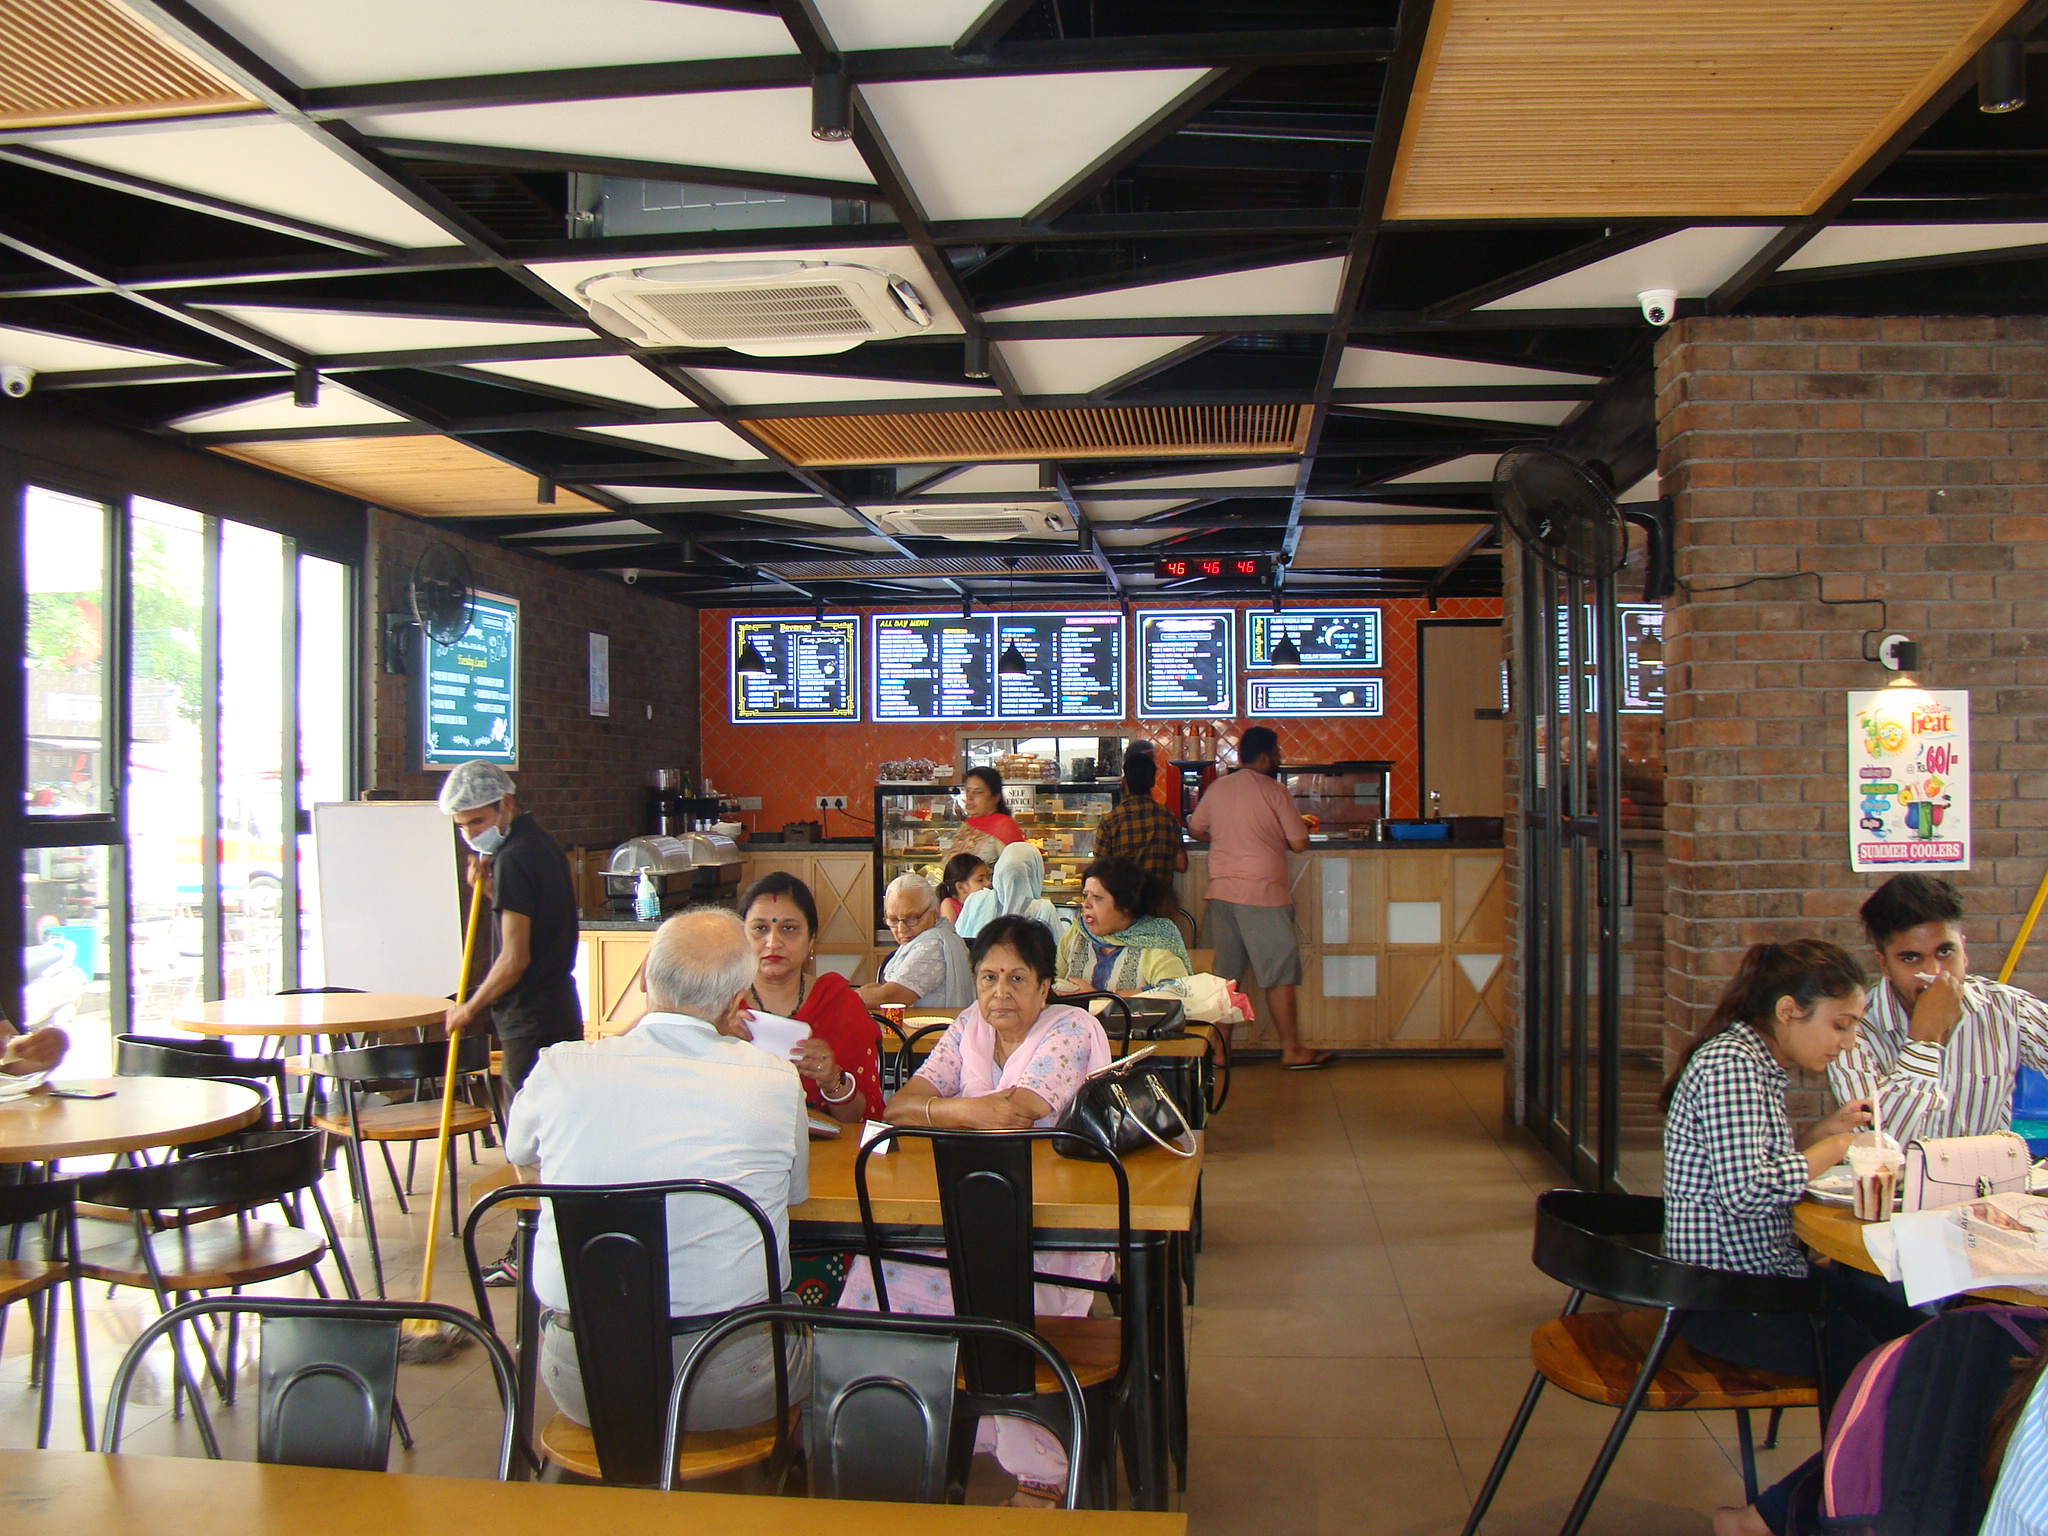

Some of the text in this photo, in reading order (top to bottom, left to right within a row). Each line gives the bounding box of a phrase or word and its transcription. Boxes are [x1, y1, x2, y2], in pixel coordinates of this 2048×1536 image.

[1168, 560, 1255, 575] 46 46 46
[894, 620, 909, 628] DAY
[1910, 711, 1951, 735] heat
[1008, 789, 1026, 797] SELF
[1006, 798, 1032, 806] ERVICE
[1860, 843, 1960, 859] SUMMER COOLERS
